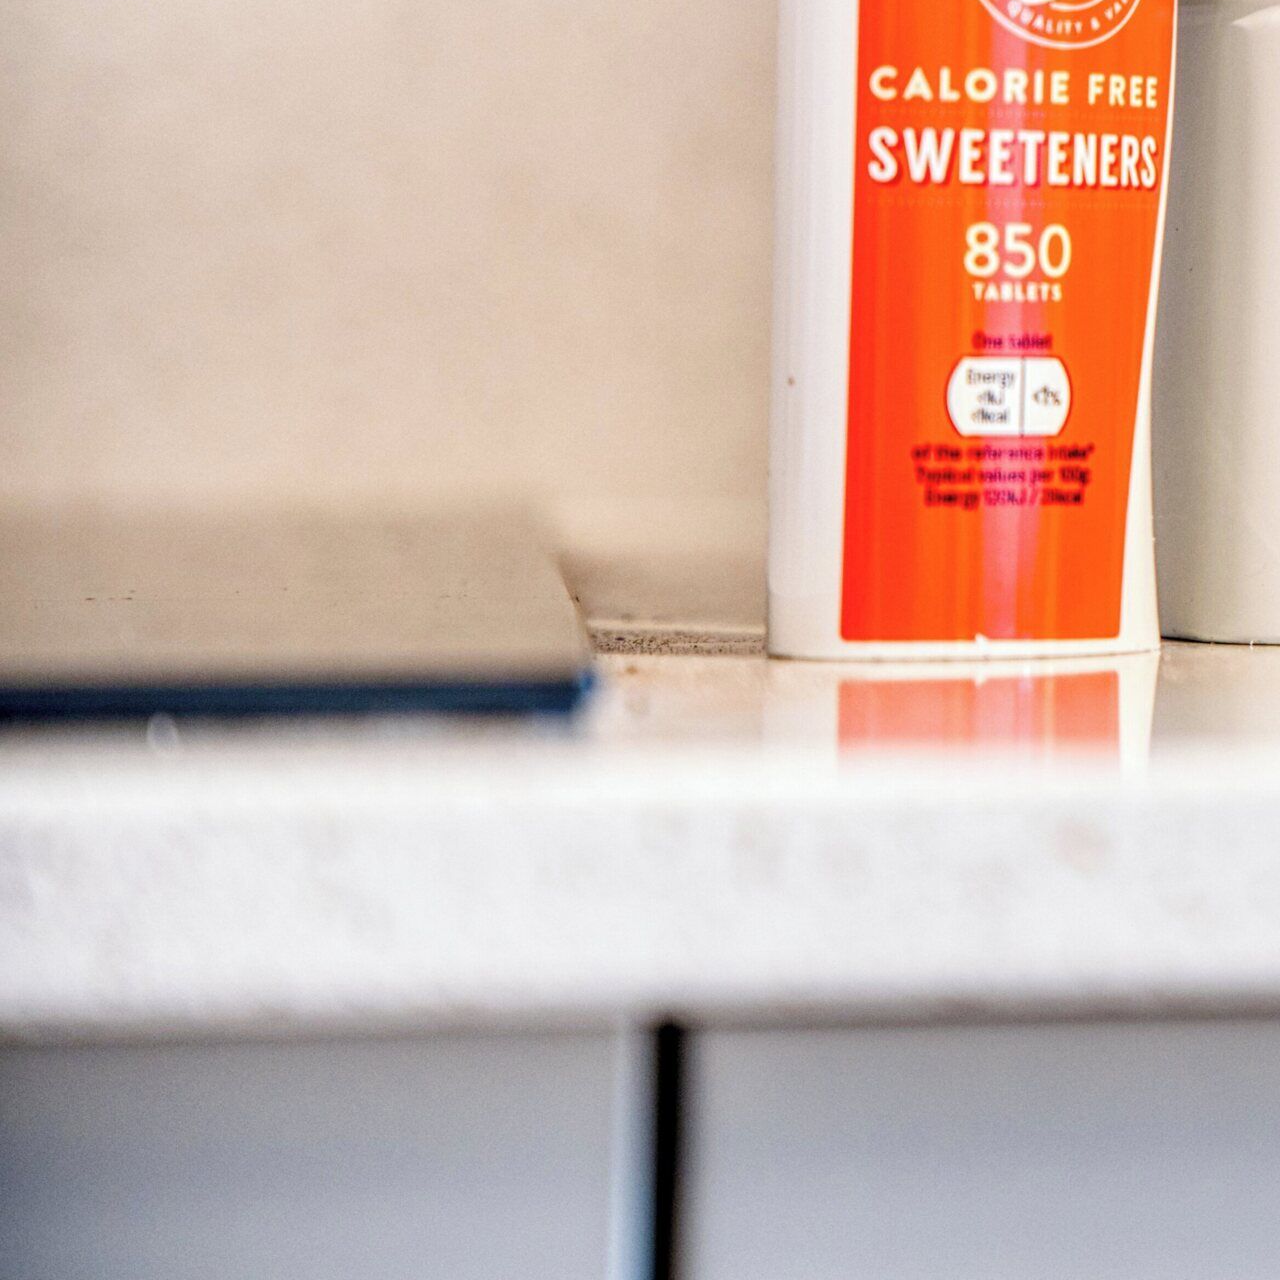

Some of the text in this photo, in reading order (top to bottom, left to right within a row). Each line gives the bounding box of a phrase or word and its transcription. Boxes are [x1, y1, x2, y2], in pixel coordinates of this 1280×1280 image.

[868, 65, 1159, 109] CALORIE FREE
[867, 125, 1158, 189] SWEETENERS
[963, 221, 1073, 279] 850
[971, 282, 1063, 303] TABLETS
[966, 368, 1016, 388] Energy
